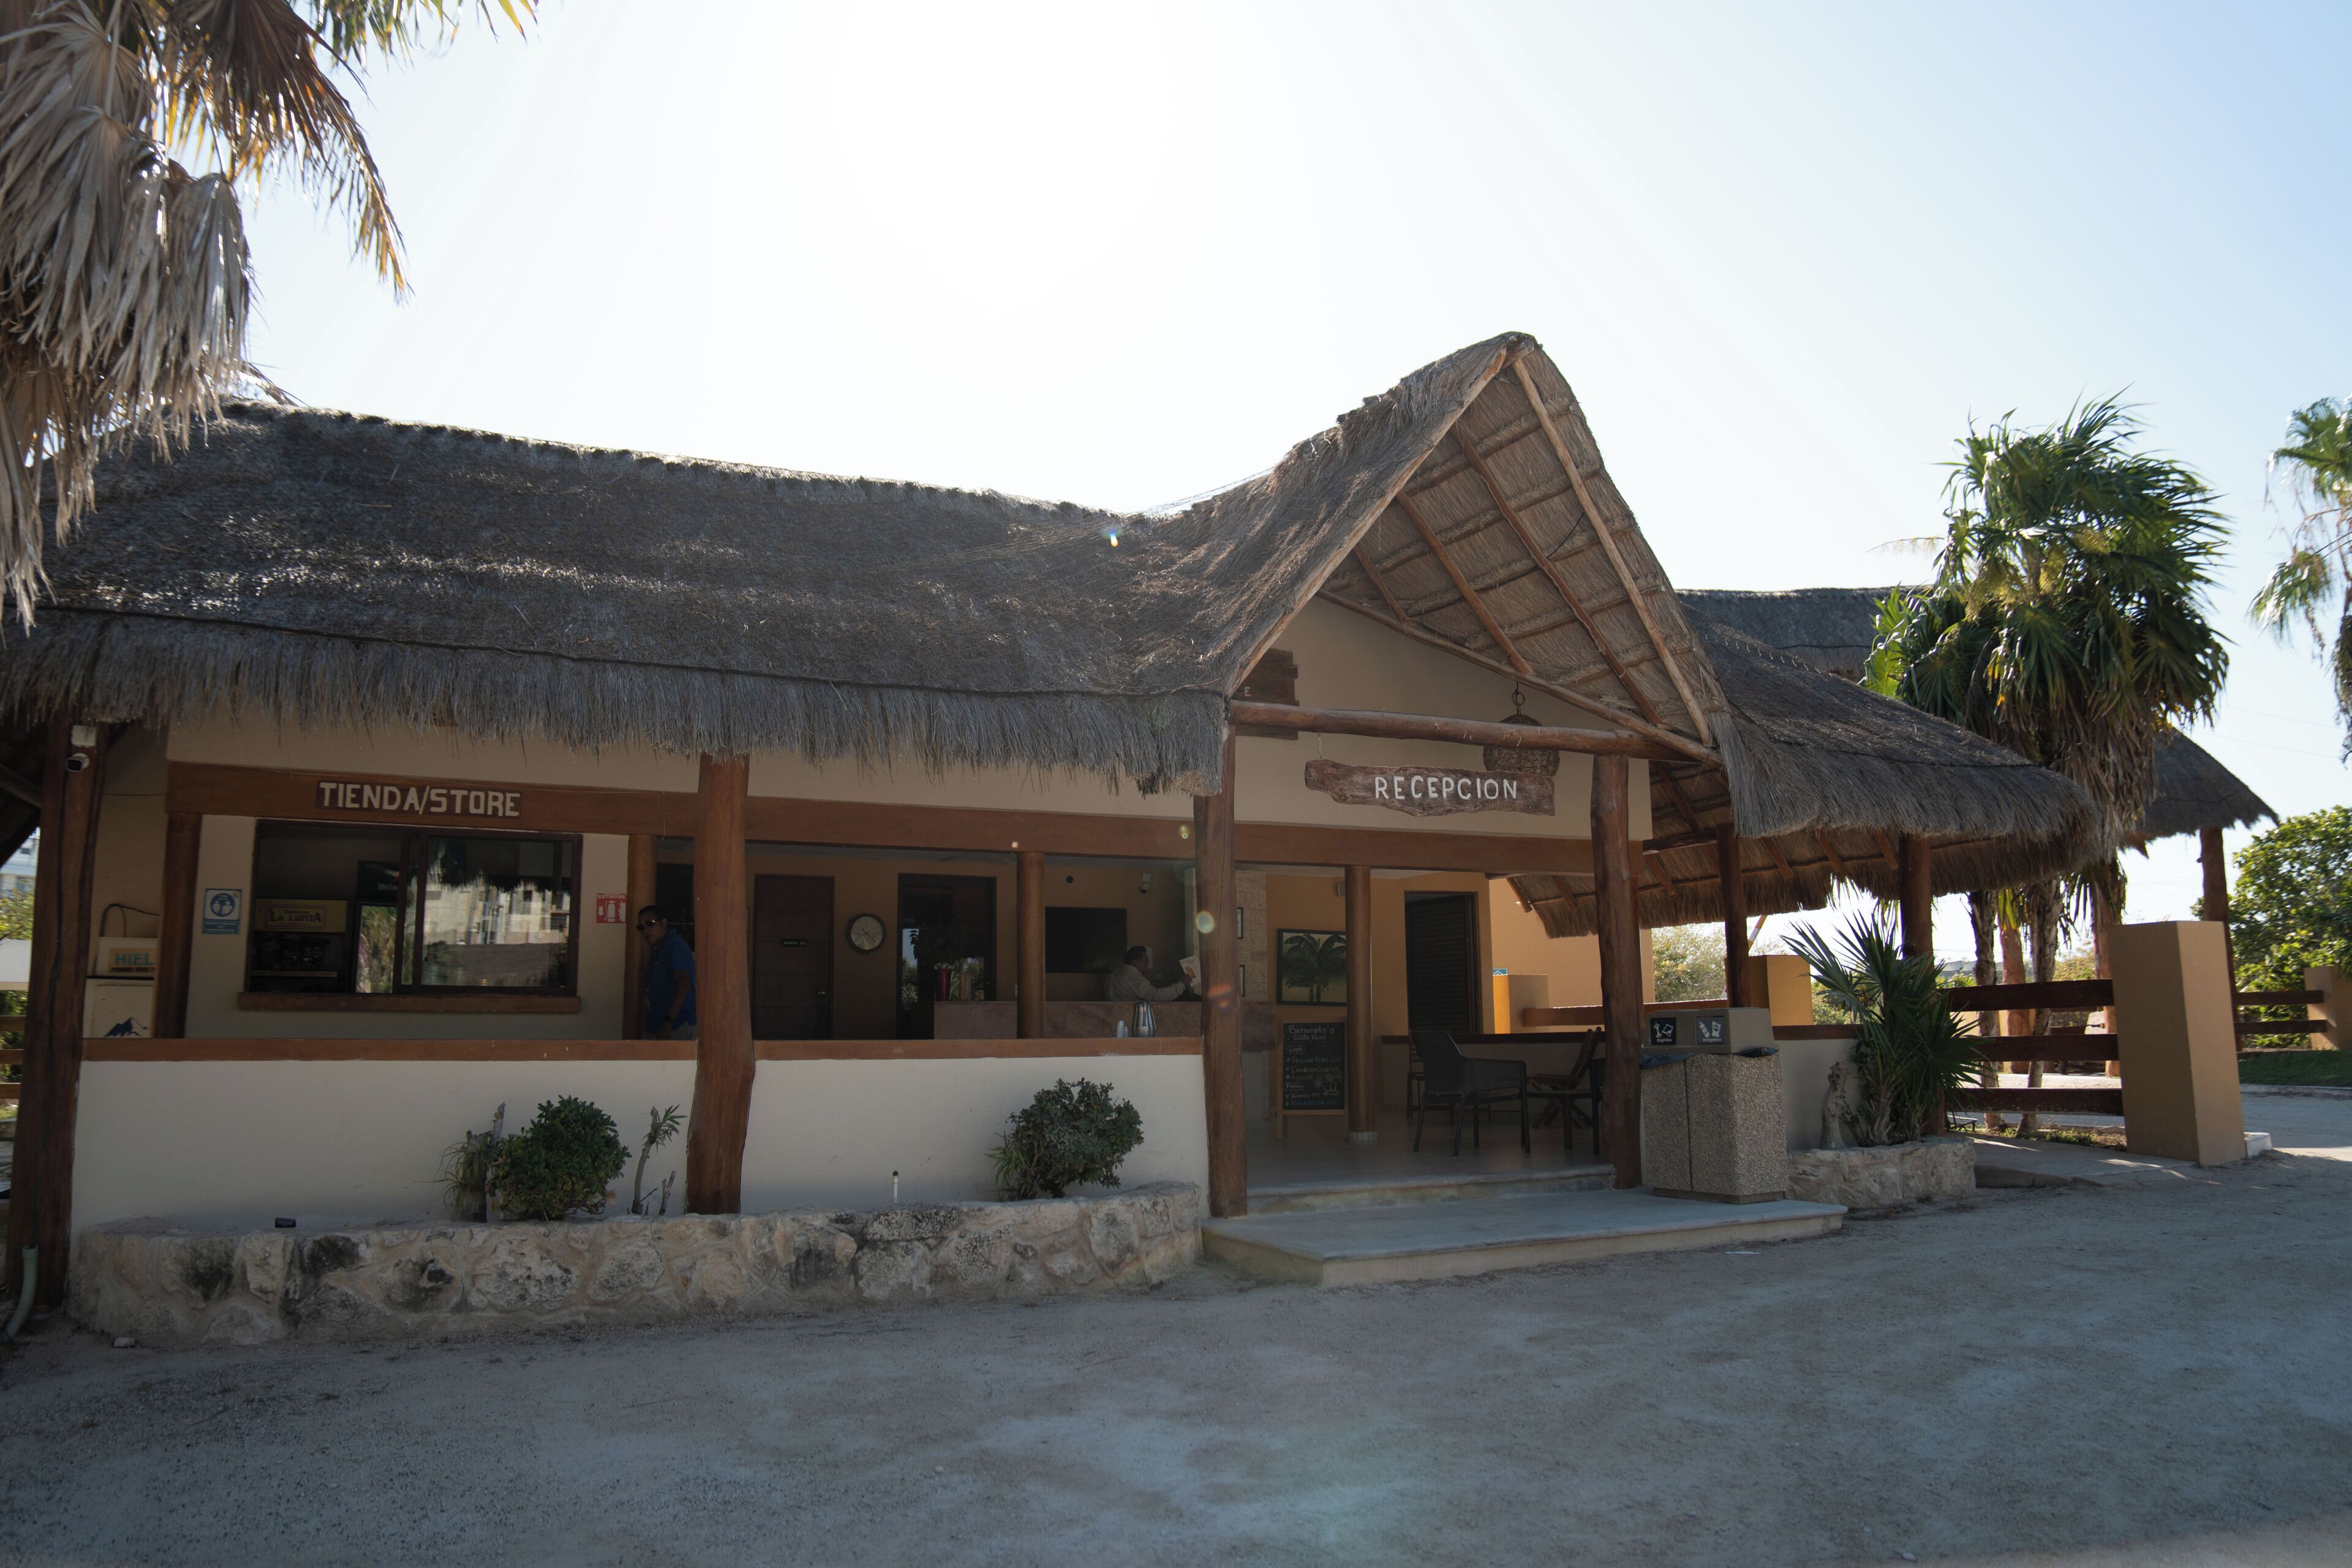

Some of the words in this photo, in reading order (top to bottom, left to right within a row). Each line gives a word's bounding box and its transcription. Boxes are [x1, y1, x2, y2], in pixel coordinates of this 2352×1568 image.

[1374, 775, 1517, 800] RECEPCION
[319, 782, 521, 817] TIENDA/STORE
[115, 953, 157, 966] HIEL
[1288, 1025, 1327, 1034] Bienvenidos
